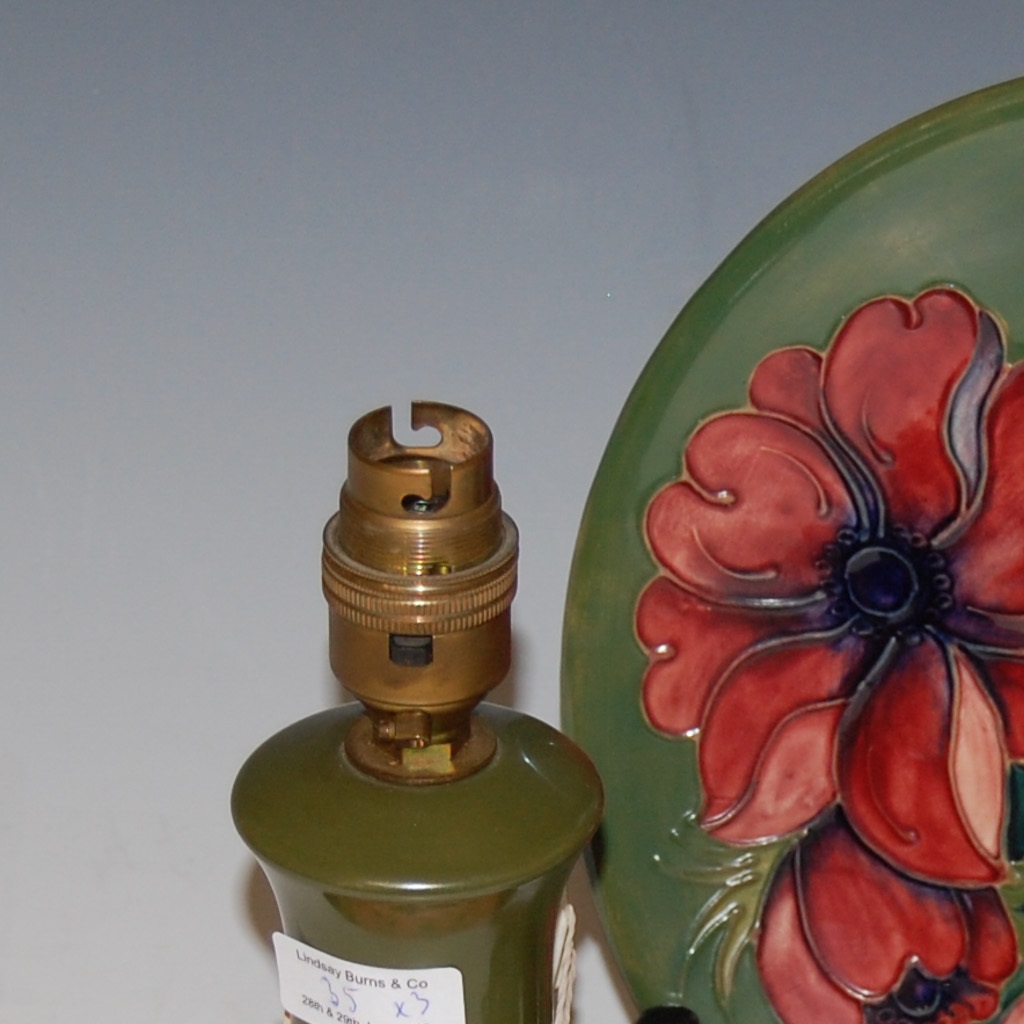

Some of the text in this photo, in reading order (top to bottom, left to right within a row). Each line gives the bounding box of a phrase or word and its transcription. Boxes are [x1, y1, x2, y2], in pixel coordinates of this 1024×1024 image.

[296, 949, 428, 989] Lindsay Burns & Co
[302, 995, 324, 1013] 28th
[327, 1009, 333, 1018] &
